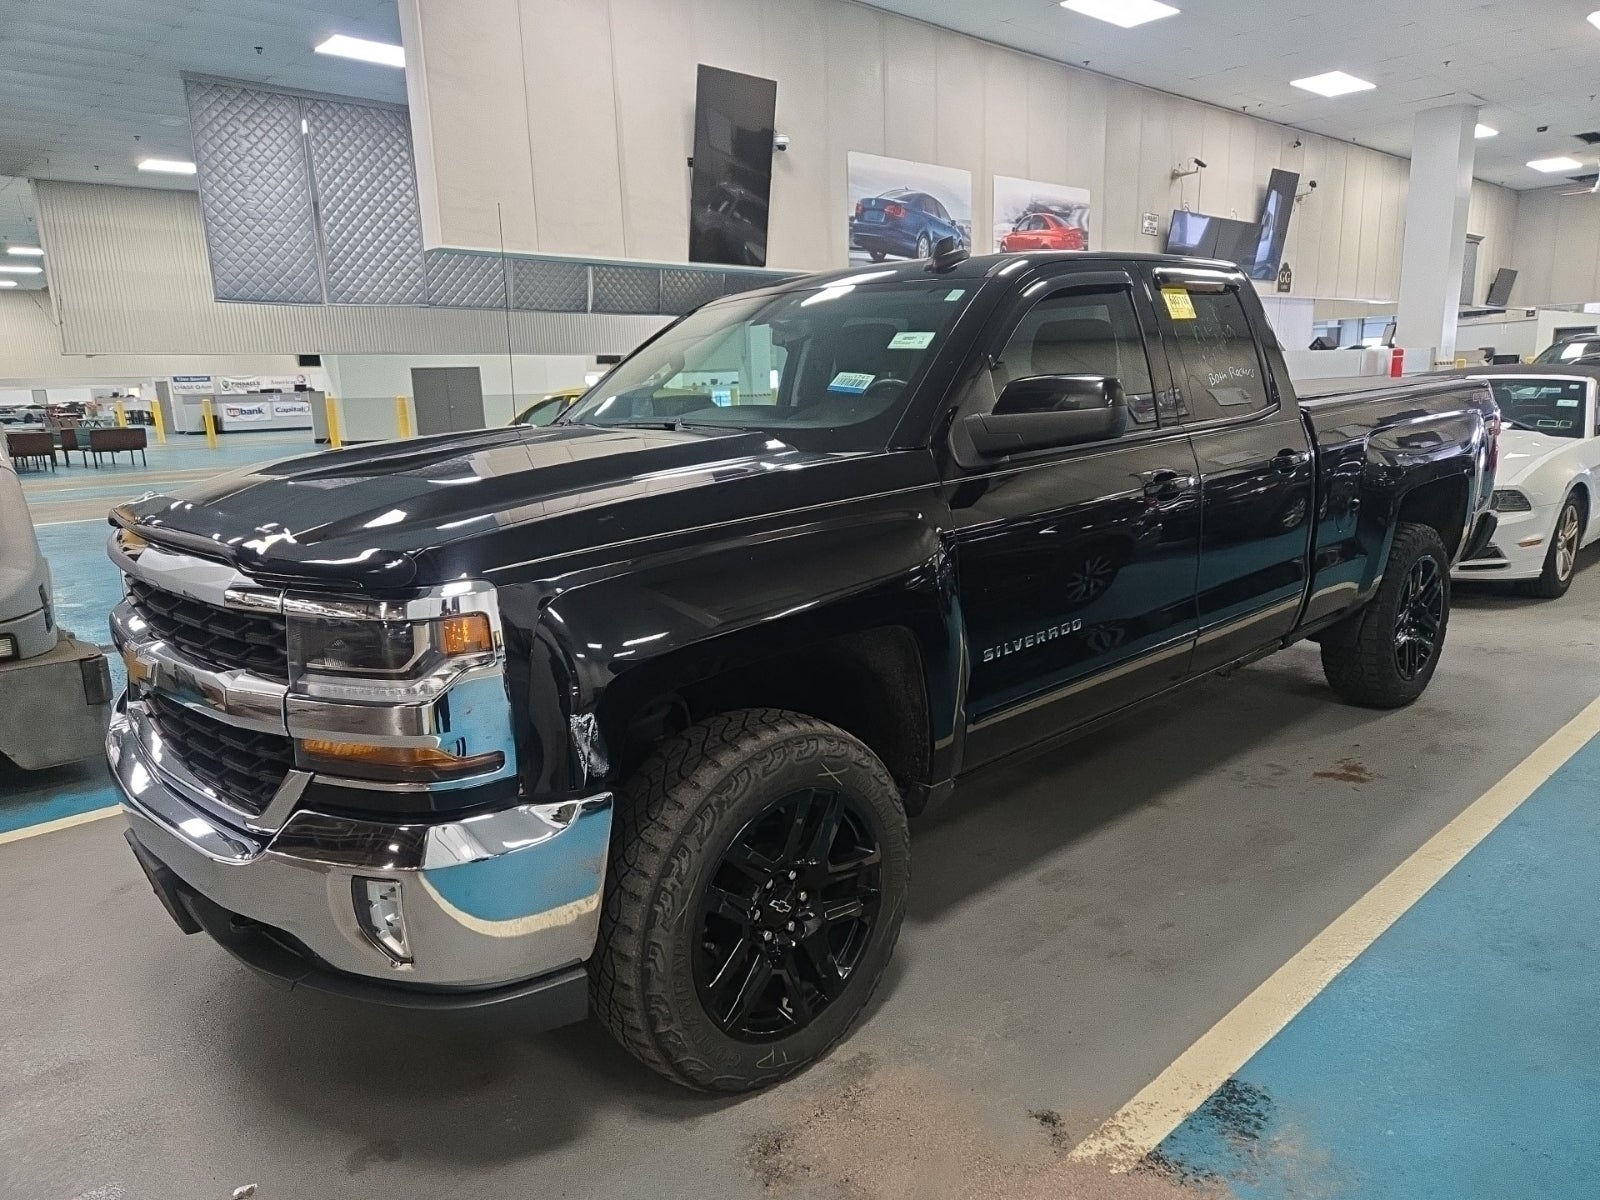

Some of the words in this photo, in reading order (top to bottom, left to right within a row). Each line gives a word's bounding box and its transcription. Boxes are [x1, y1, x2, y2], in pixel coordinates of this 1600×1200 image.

[1280, 271, 1291, 283] GG
[275, 406, 303, 414] Capital
[983, 618, 1082, 662] SILVERADO
